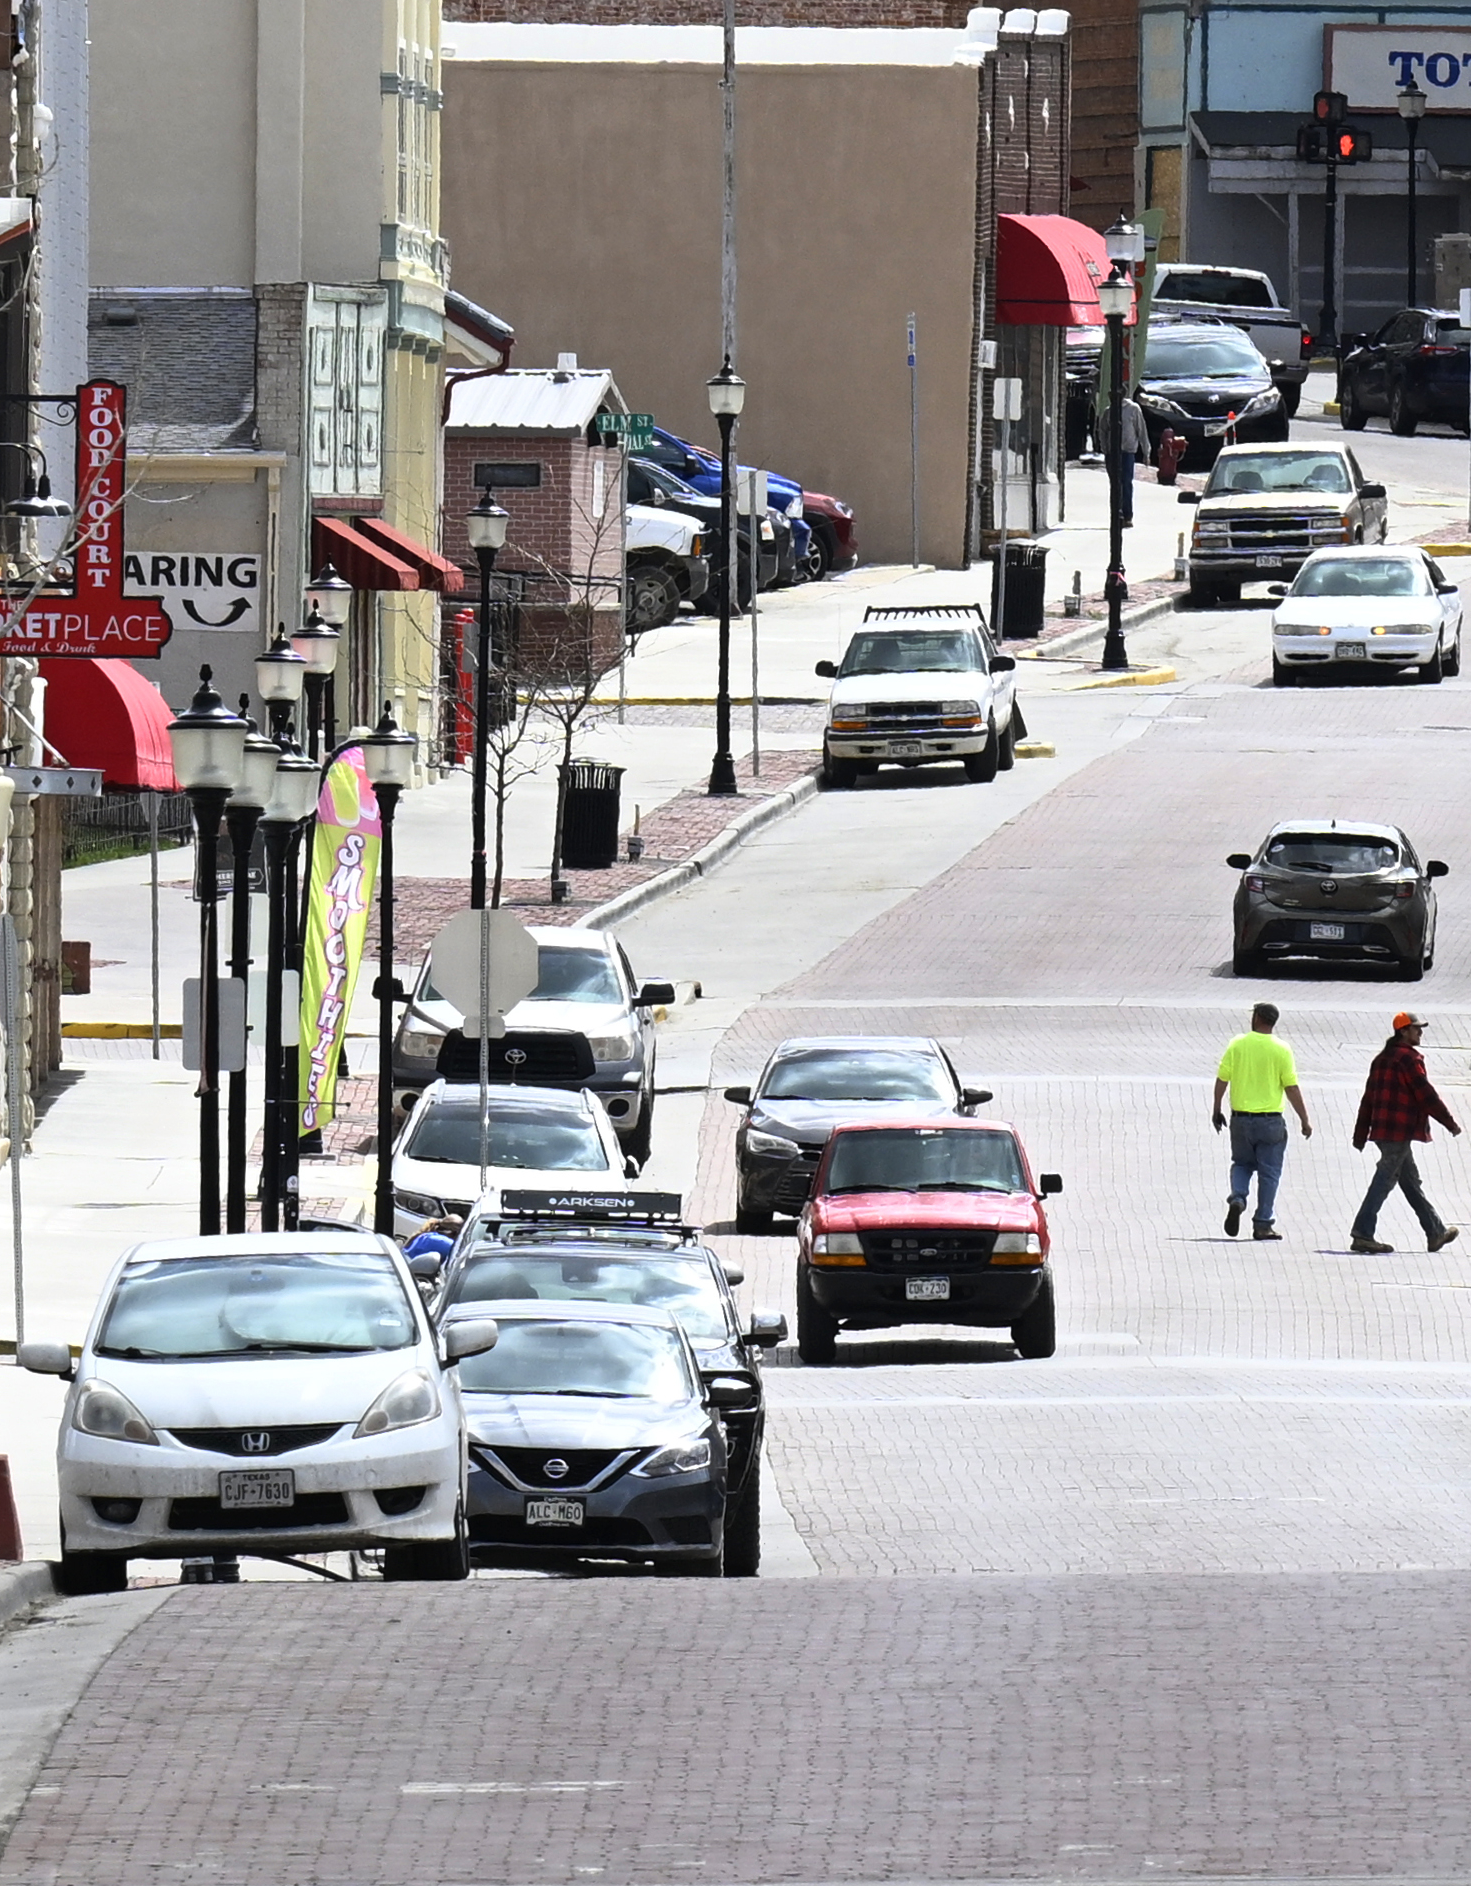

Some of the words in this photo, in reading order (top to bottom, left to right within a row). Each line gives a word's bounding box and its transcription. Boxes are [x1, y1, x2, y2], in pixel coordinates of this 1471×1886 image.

[89, 387, 113, 468] FOOD
[602, 415, 632, 432] ELM
[87, 477, 112, 588] COURT
[2, 640, 37, 653] Food
[557, 1197, 627, 1208] ARKSEN
